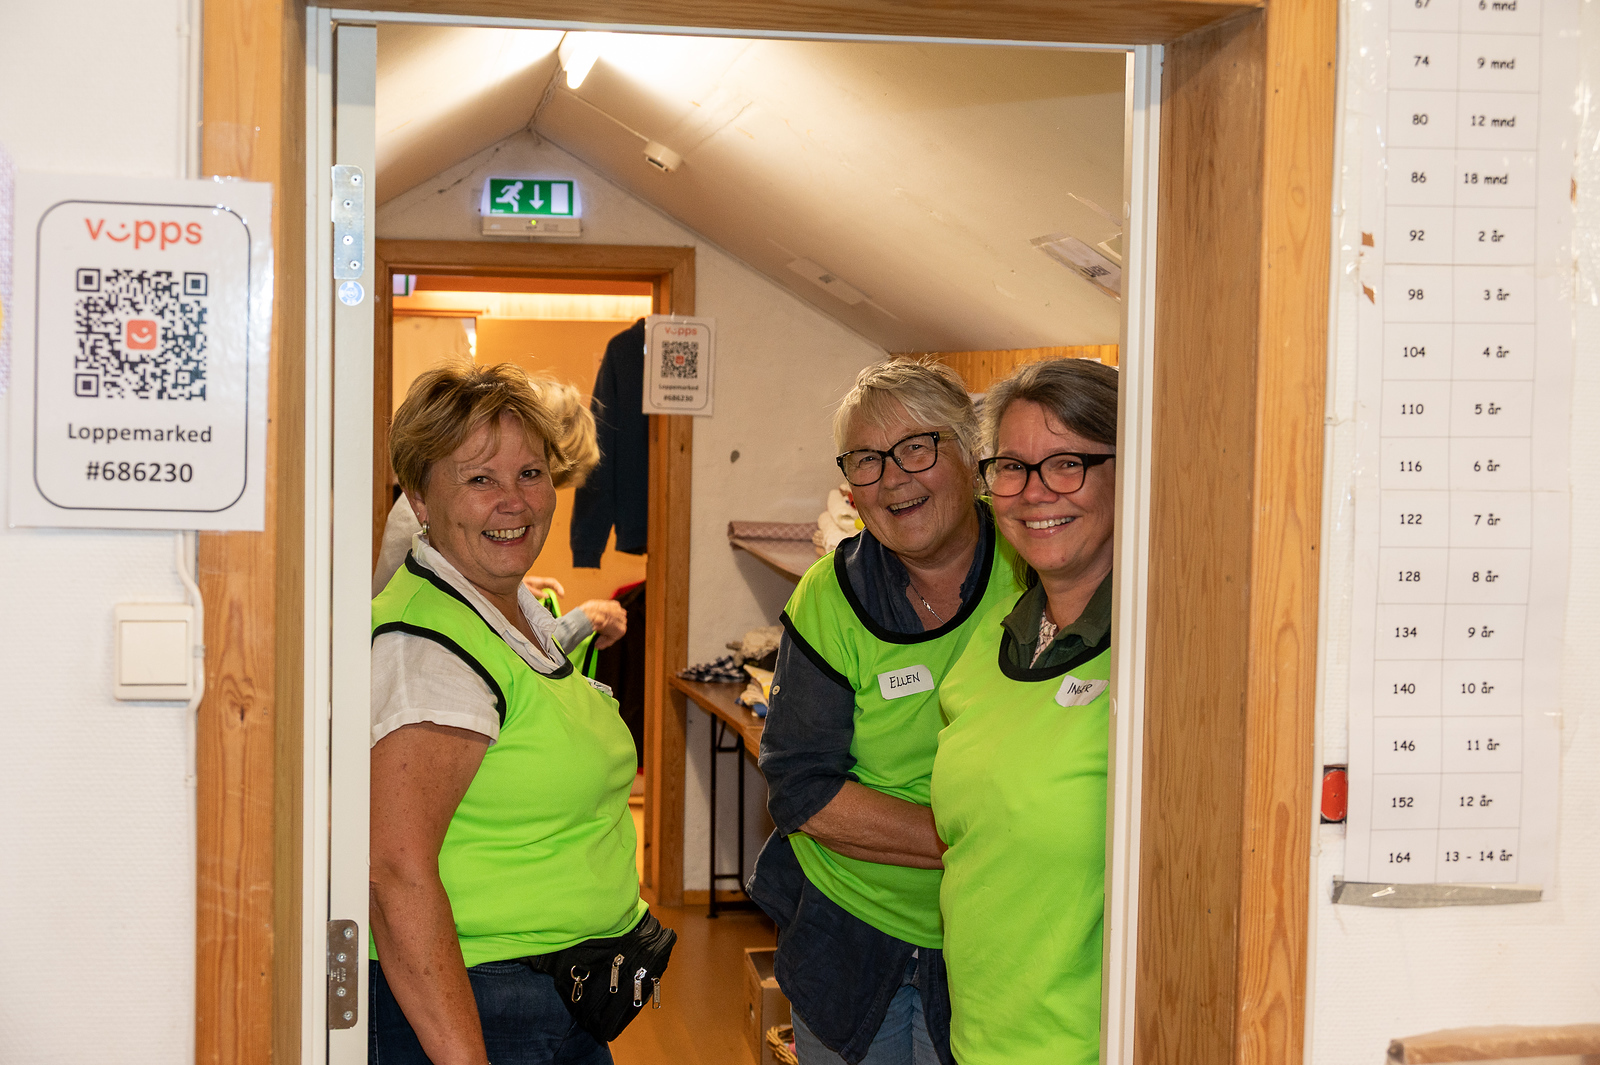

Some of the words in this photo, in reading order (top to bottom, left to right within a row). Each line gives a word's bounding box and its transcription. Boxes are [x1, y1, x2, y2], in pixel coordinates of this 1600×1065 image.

[1414, 0, 1430, 9] 67
[1478, 0, 1487, 11] 6
[1492, 0, 1517, 12] mnd
[1413, 55, 1430, 67] 74
[1477, 57, 1486, 69] 9
[1490, 58, 1515, 70] mnd
[1412, 113, 1429, 126] 80
[1470, 115, 1486, 127] 12
[1490, 116, 1516, 128] mnd
[1410, 171, 1427, 184] 86
[1463, 172, 1479, 185] 18
[1483, 173, 1508, 185] mnd
[84, 217, 204, 251] vipps
[1409, 229, 1425, 242] 92
[1478, 230, 1486, 243] 2
[1490, 229, 1505, 243] år
[1407, 288, 1424, 301] 98
[1483, 289, 1491, 301] 3
[1496, 288, 1510, 301] år
[1402, 346, 1426, 358] 104
[1482, 346, 1491, 358] 4
[1495, 345, 1510, 359] år
[1400, 403, 1425, 415] 110
[1474, 403, 1483, 416] 5
[1487, 402, 1502, 416] år
[68, 422, 213, 444] Loppemarked
[86, 461, 194, 483] #686230
[1399, 460, 1423, 473] 116
[1473, 460, 1482, 473] 6
[1486, 459, 1501, 472] år
[1399, 513, 1423, 525] 122
[1473, 514, 1482, 526] 7
[1486, 512, 1501, 526] år
[1398, 570, 1421, 583] 128
[1471, 571, 1480, 583] 8
[1485, 569, 1499, 583] år
[1395, 626, 1418, 638] 134
[1467, 626, 1476, 639] 9
[1480, 625, 1495, 638] år
[888, 671, 921, 690] ELLEN
[1067, 682, 1093, 696] INGER
[1392, 682, 1416, 695] 140
[1460, 682, 1476, 695] 10
[1480, 681, 1495, 694] år
[1392, 740, 1416, 752] 146
[1466, 739, 1480, 751] 11
[1486, 737, 1500, 751] år
[1391, 796, 1414, 809] 152
[1458, 795, 1474, 807] 12
[1479, 794, 1493, 807] år
[1388, 851, 1411, 864] 164
[1445, 851, 1460, 863] 13
[1479, 850, 1494, 862] 14
[1499, 849, 1513, 862] år
